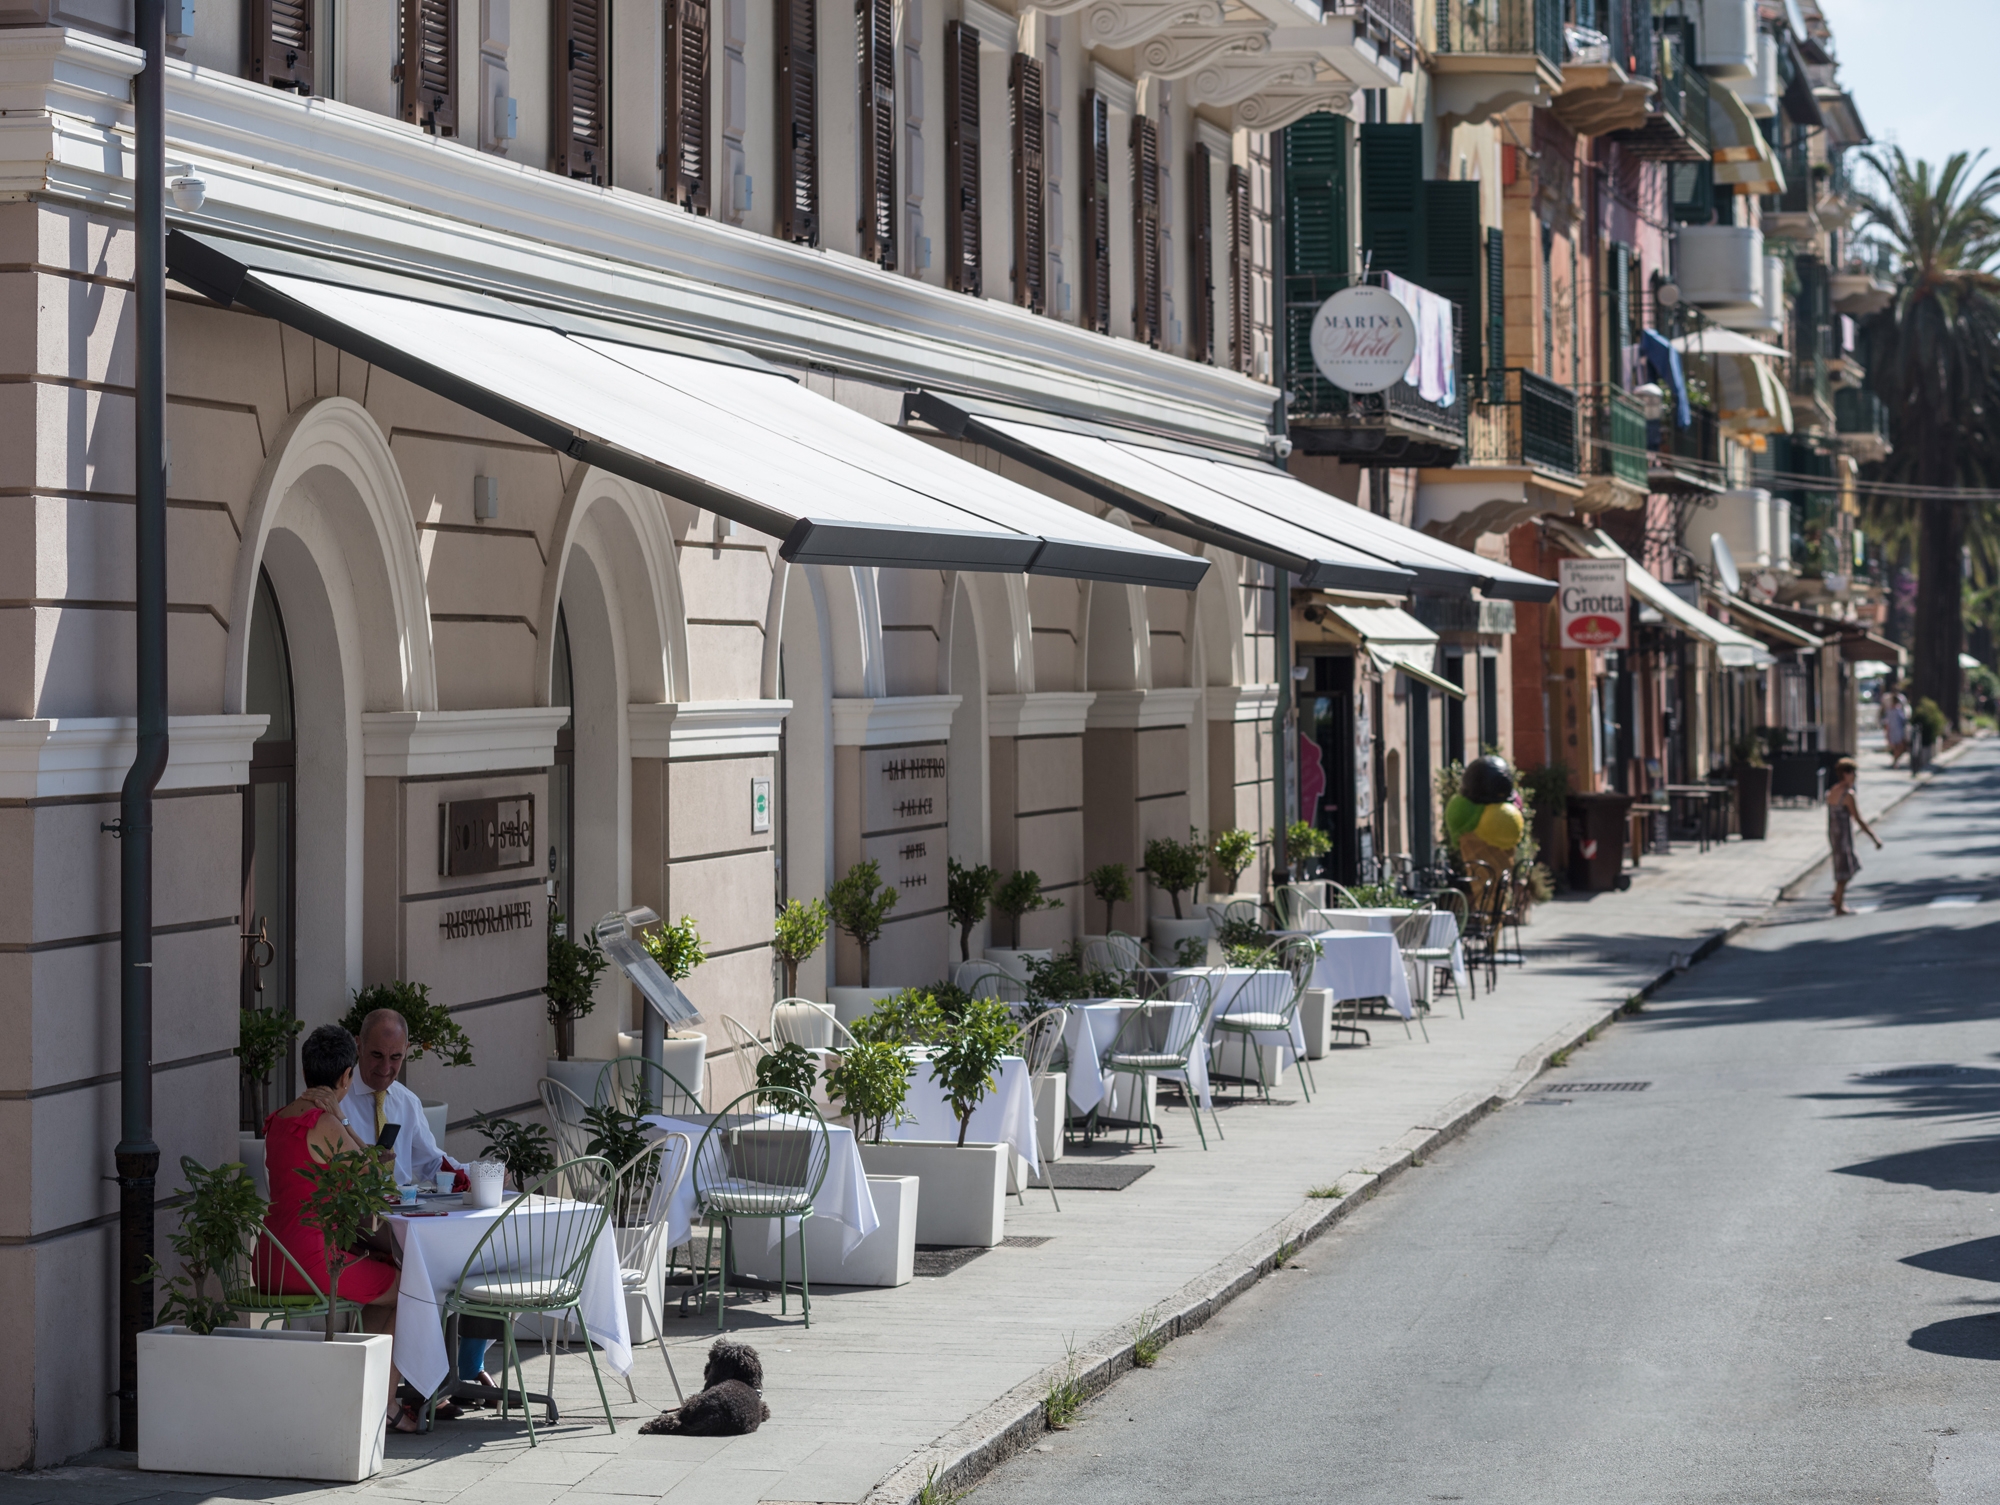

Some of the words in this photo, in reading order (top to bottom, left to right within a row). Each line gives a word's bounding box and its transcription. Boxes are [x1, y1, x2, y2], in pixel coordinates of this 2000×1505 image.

[1324, 315, 1403, 328] MARINA
[1322, 325, 1402, 358] Hotel
[1562, 587, 1625, 613] Grotta
[888, 758, 906, 781] SAN
[910, 757, 946, 780] PIETRO
[901, 797, 933, 818] PALACE
[905, 841, 927, 860] HOTEL
[445, 901, 533, 940] RISTORANTE
